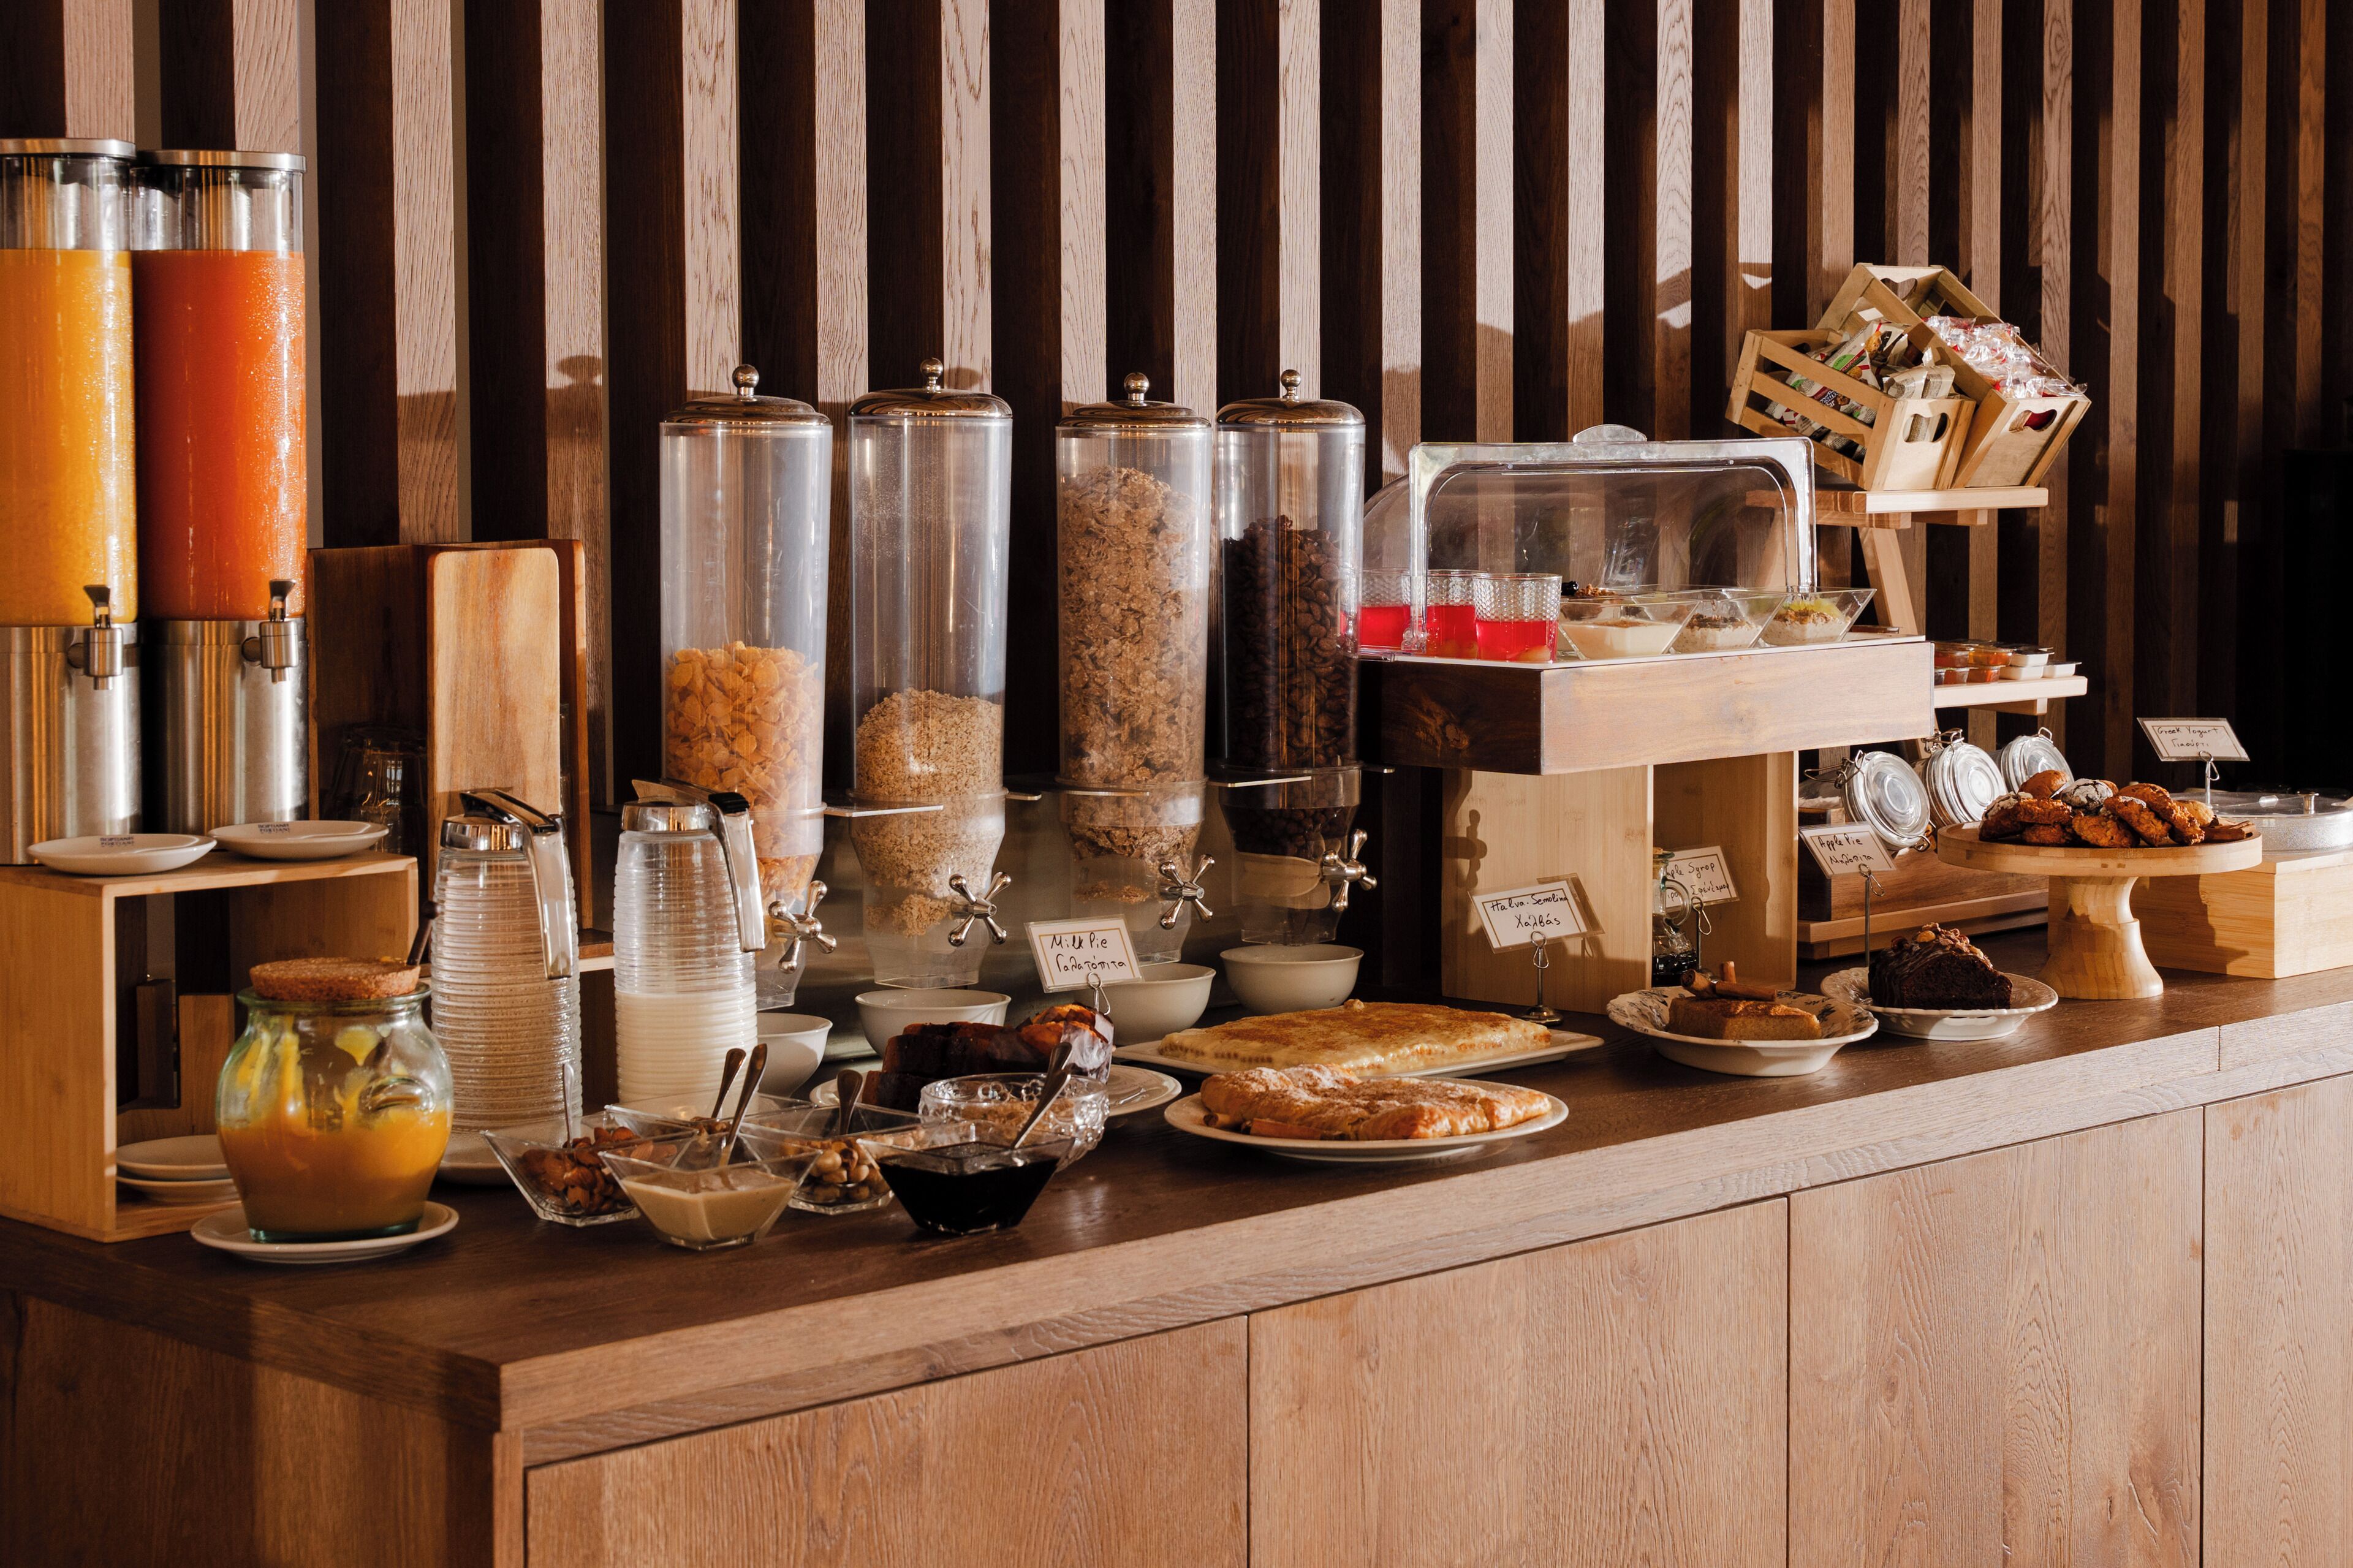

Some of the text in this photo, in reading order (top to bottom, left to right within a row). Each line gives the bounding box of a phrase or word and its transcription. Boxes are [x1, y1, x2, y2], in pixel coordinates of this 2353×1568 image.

[2186, 727, 2219, 738] Yogurt
[1817, 832, 1863, 852] Apple Pie
[1666, 864, 1684, 879] aple
[1531, 893, 1569, 906] Semolina
[1050, 931, 1108, 950] Milk Pie
